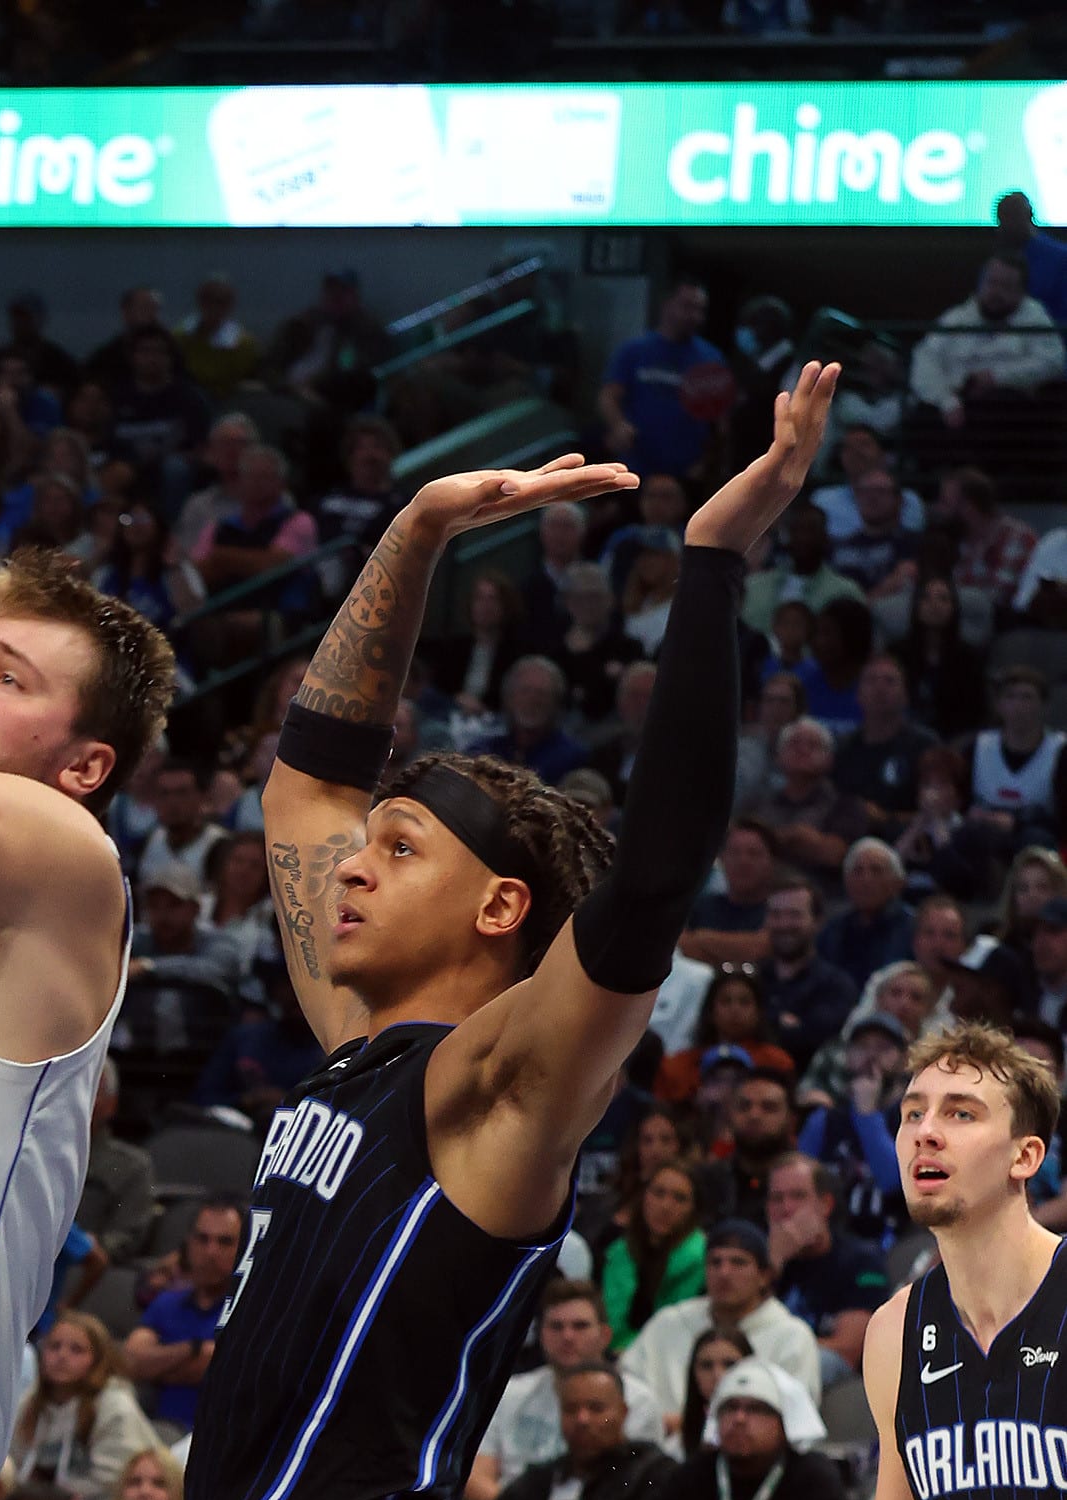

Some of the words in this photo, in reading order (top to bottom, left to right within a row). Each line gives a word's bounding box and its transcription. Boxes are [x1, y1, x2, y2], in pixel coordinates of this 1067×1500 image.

[668, 103, 966, 205] chime
[922, 1324, 937, 1351] 6
[1020, 1346, 1059, 1367] Disney
